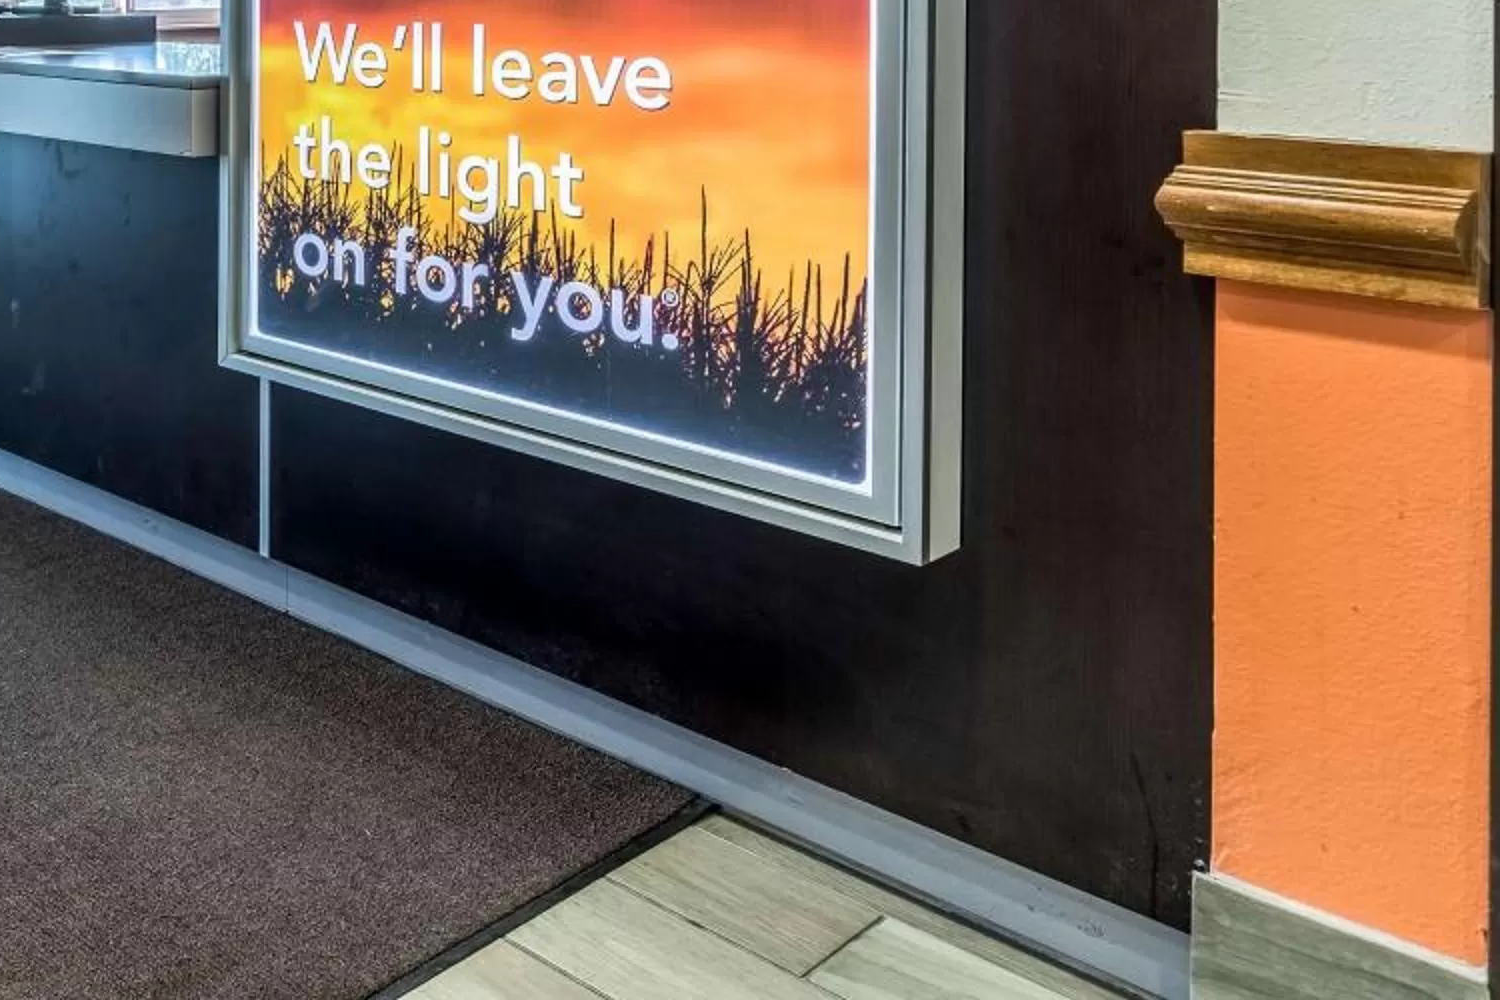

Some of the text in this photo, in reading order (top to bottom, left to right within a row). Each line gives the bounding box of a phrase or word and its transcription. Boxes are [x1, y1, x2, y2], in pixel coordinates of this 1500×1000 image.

[293, 20, 672, 111] We'll leave
[293, 115, 584, 224] the light
[293, 233, 365, 286] on
[389, 225, 489, 309] for
